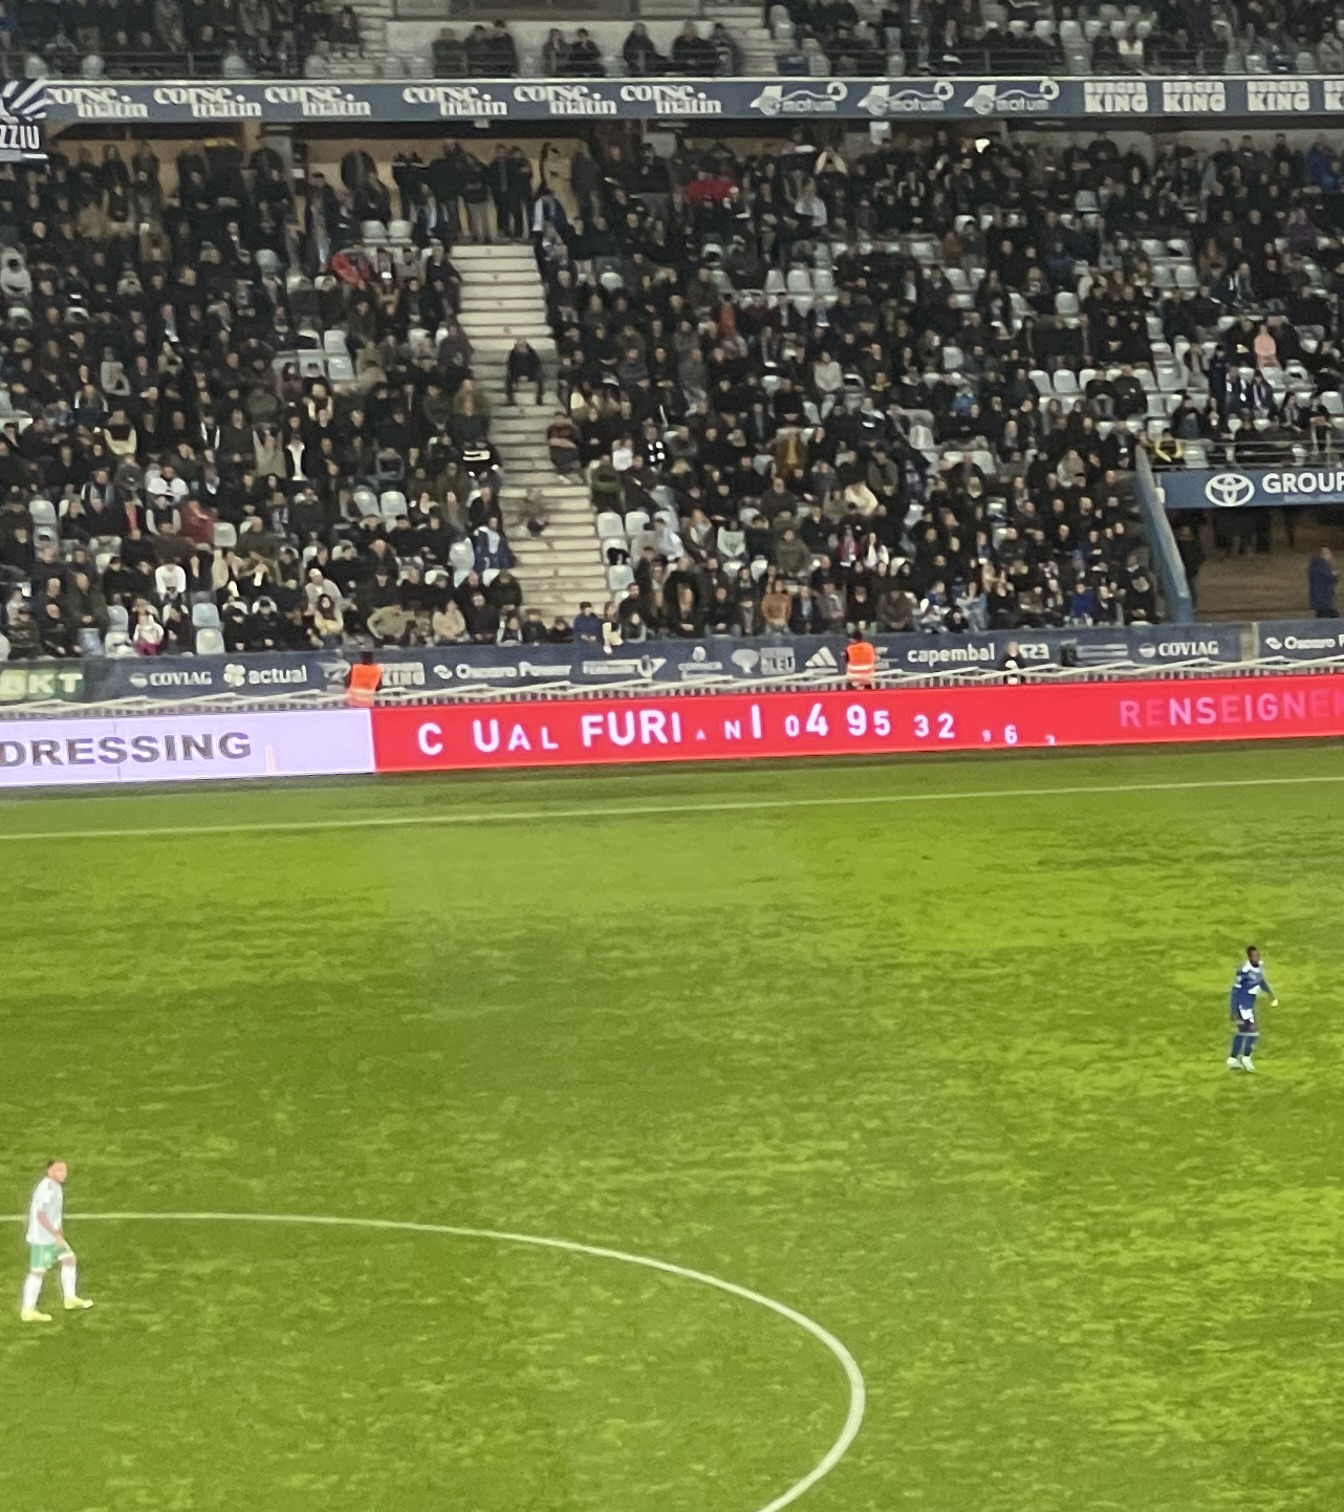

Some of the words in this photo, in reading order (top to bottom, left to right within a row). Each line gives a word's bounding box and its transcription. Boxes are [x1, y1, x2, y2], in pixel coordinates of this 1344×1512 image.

[154, 87, 232, 104] corse
[265, 86, 340, 104] corse
[403, 86, 479, 103] corse
[513, 86, 590, 102] corse
[620, 85, 695, 102] corse
[1248, 93, 1310, 111] KING
[77, 95, 148, 118] matin
[192, 94, 262, 117] matin
[302, 93, 371, 117] matin
[440, 92, 507, 117] matin
[550, 92, 617, 116] matin
[656, 91, 722, 115] matin
[1085, 94, 1148, 112] KING
[1163, 94, 1226, 112] KING
[908, 643, 995, 667] capembal
[1159, 641, 1219, 657] COVIAG
[150, 671, 212, 687] COVIAG
[248, 664, 307, 685] actual
[784, 702, 829, 736] 04
[846, 703, 891, 737] 95
[913, 712, 956, 740] 32
